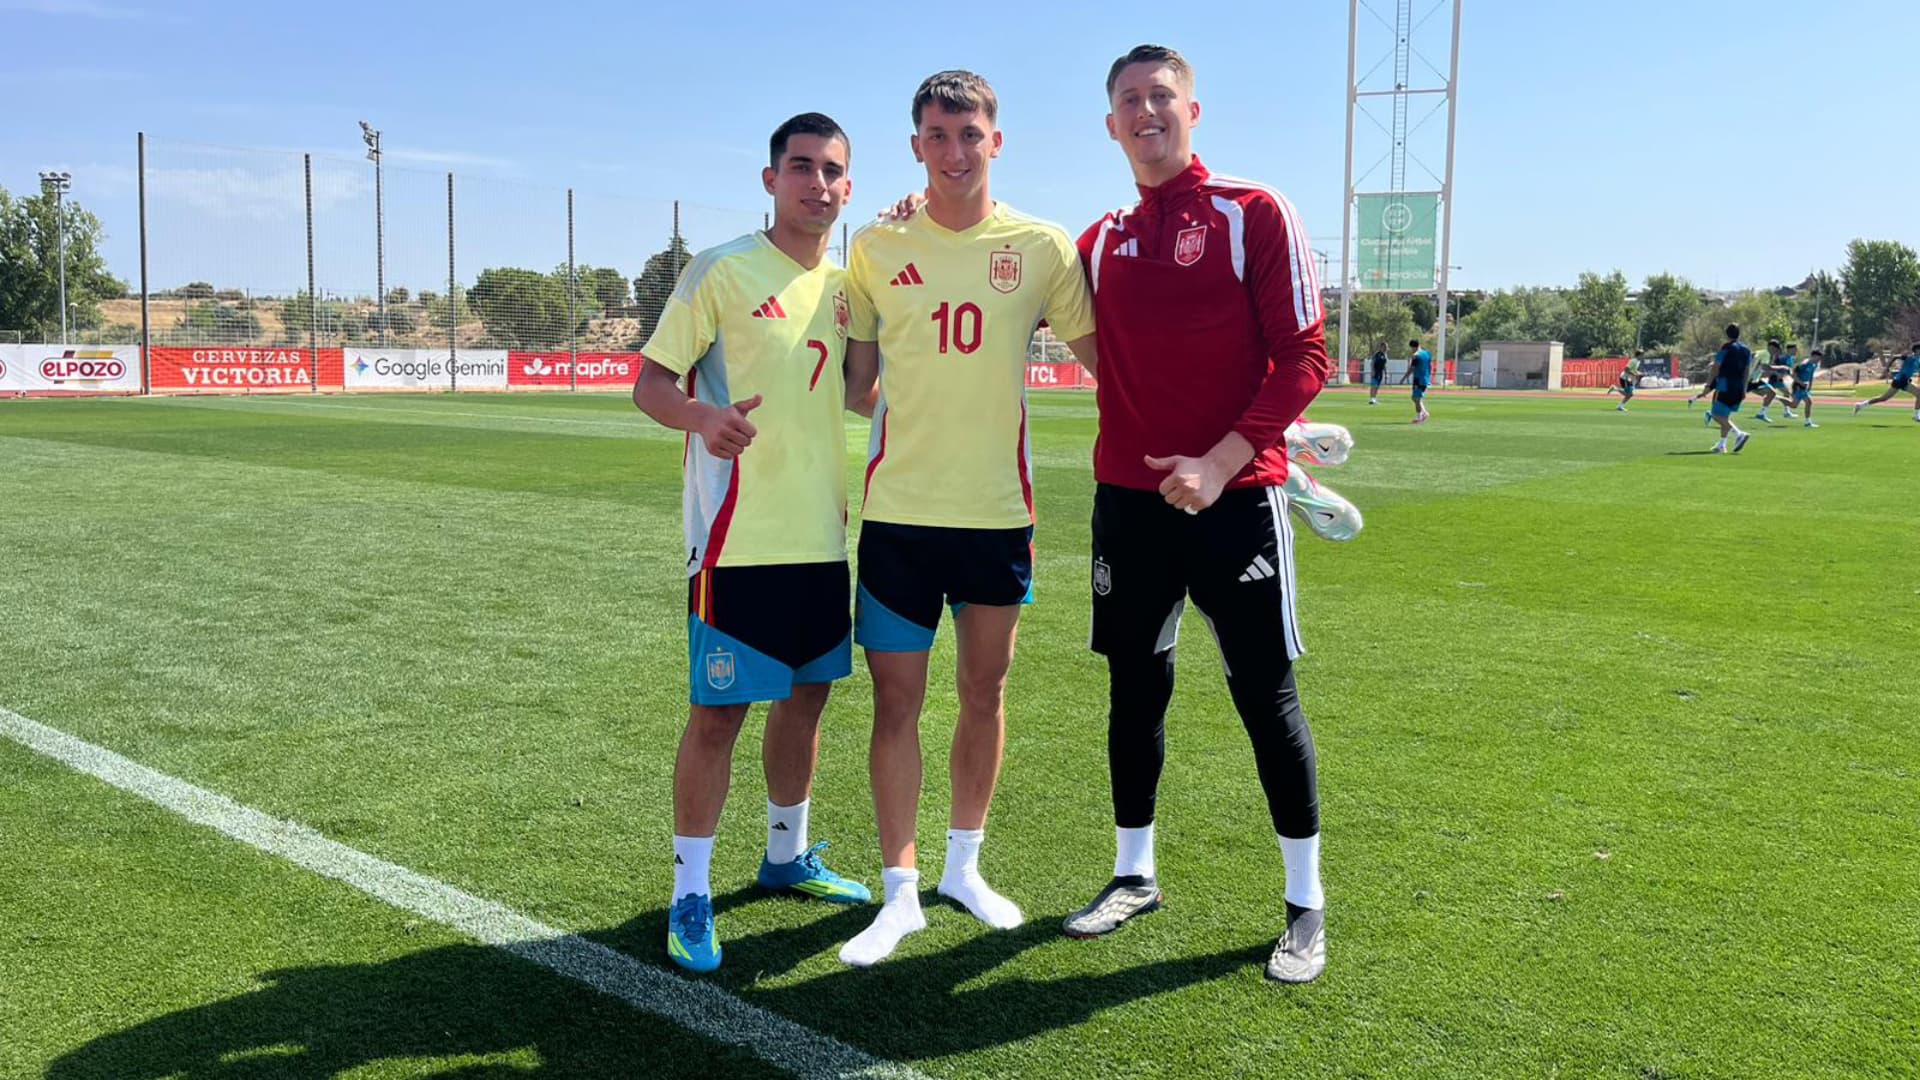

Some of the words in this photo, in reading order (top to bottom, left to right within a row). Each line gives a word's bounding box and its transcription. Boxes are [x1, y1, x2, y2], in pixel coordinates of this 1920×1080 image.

[931, 302, 982, 354] 10
[193, 350, 300, 364] CERVEZAS
[807, 339, 828, 391] 7
[182, 367, 310, 384] VICTORIA
[375, 358, 441, 379] Google
[445, 358, 504, 376] Gemini
[555, 358, 629, 378] mapfre
[1026, 366, 1057, 383] TCL
